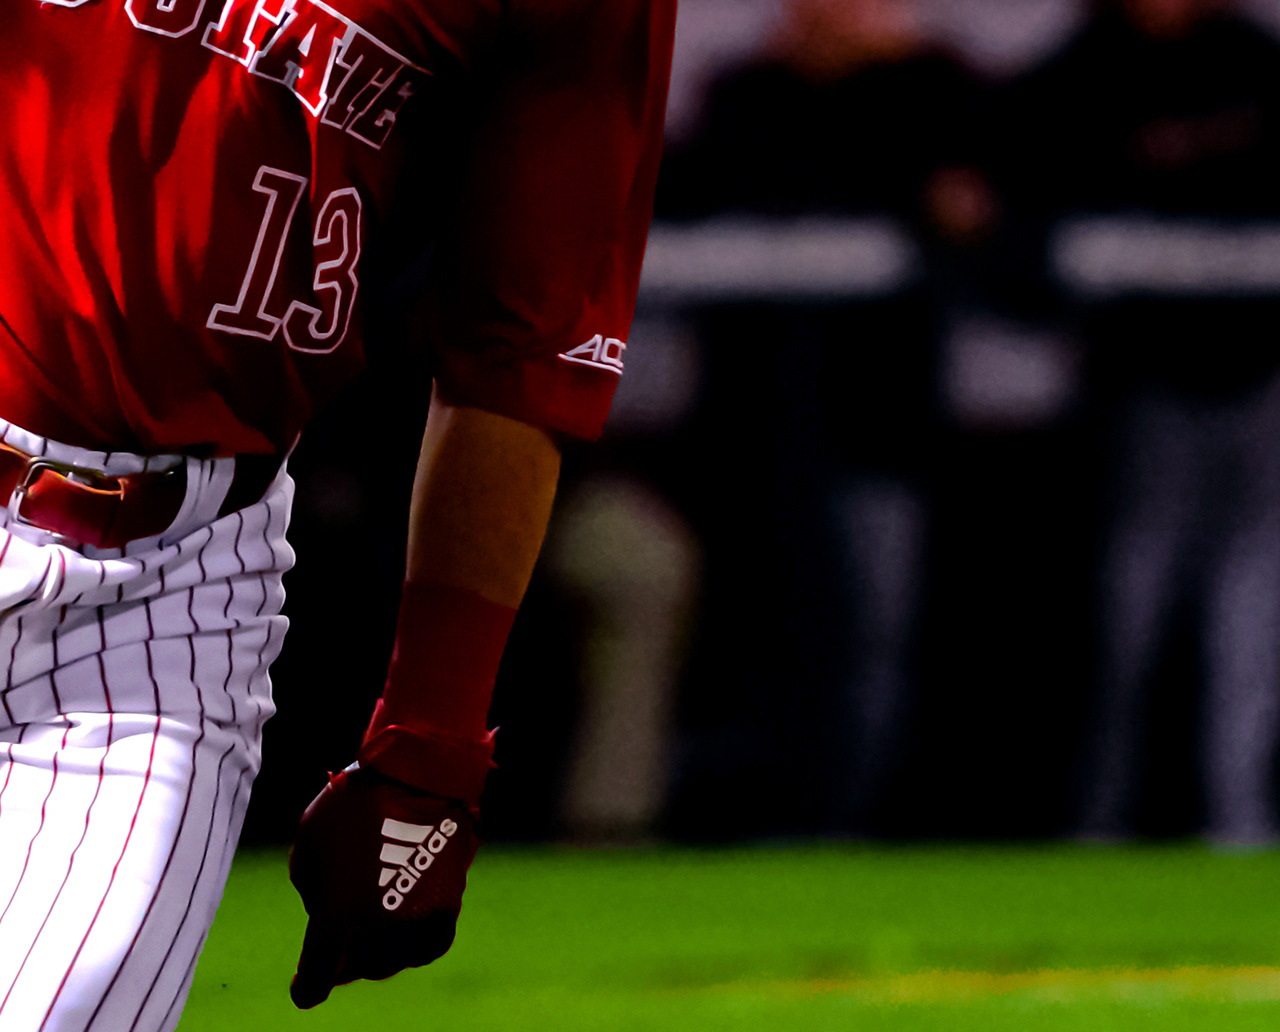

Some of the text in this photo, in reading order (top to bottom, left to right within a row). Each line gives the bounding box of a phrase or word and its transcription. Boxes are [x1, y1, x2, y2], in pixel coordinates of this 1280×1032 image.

[206, 164, 362, 354] 13
[564, 334, 626, 368] AC
[382, 818, 458, 910] adidas
